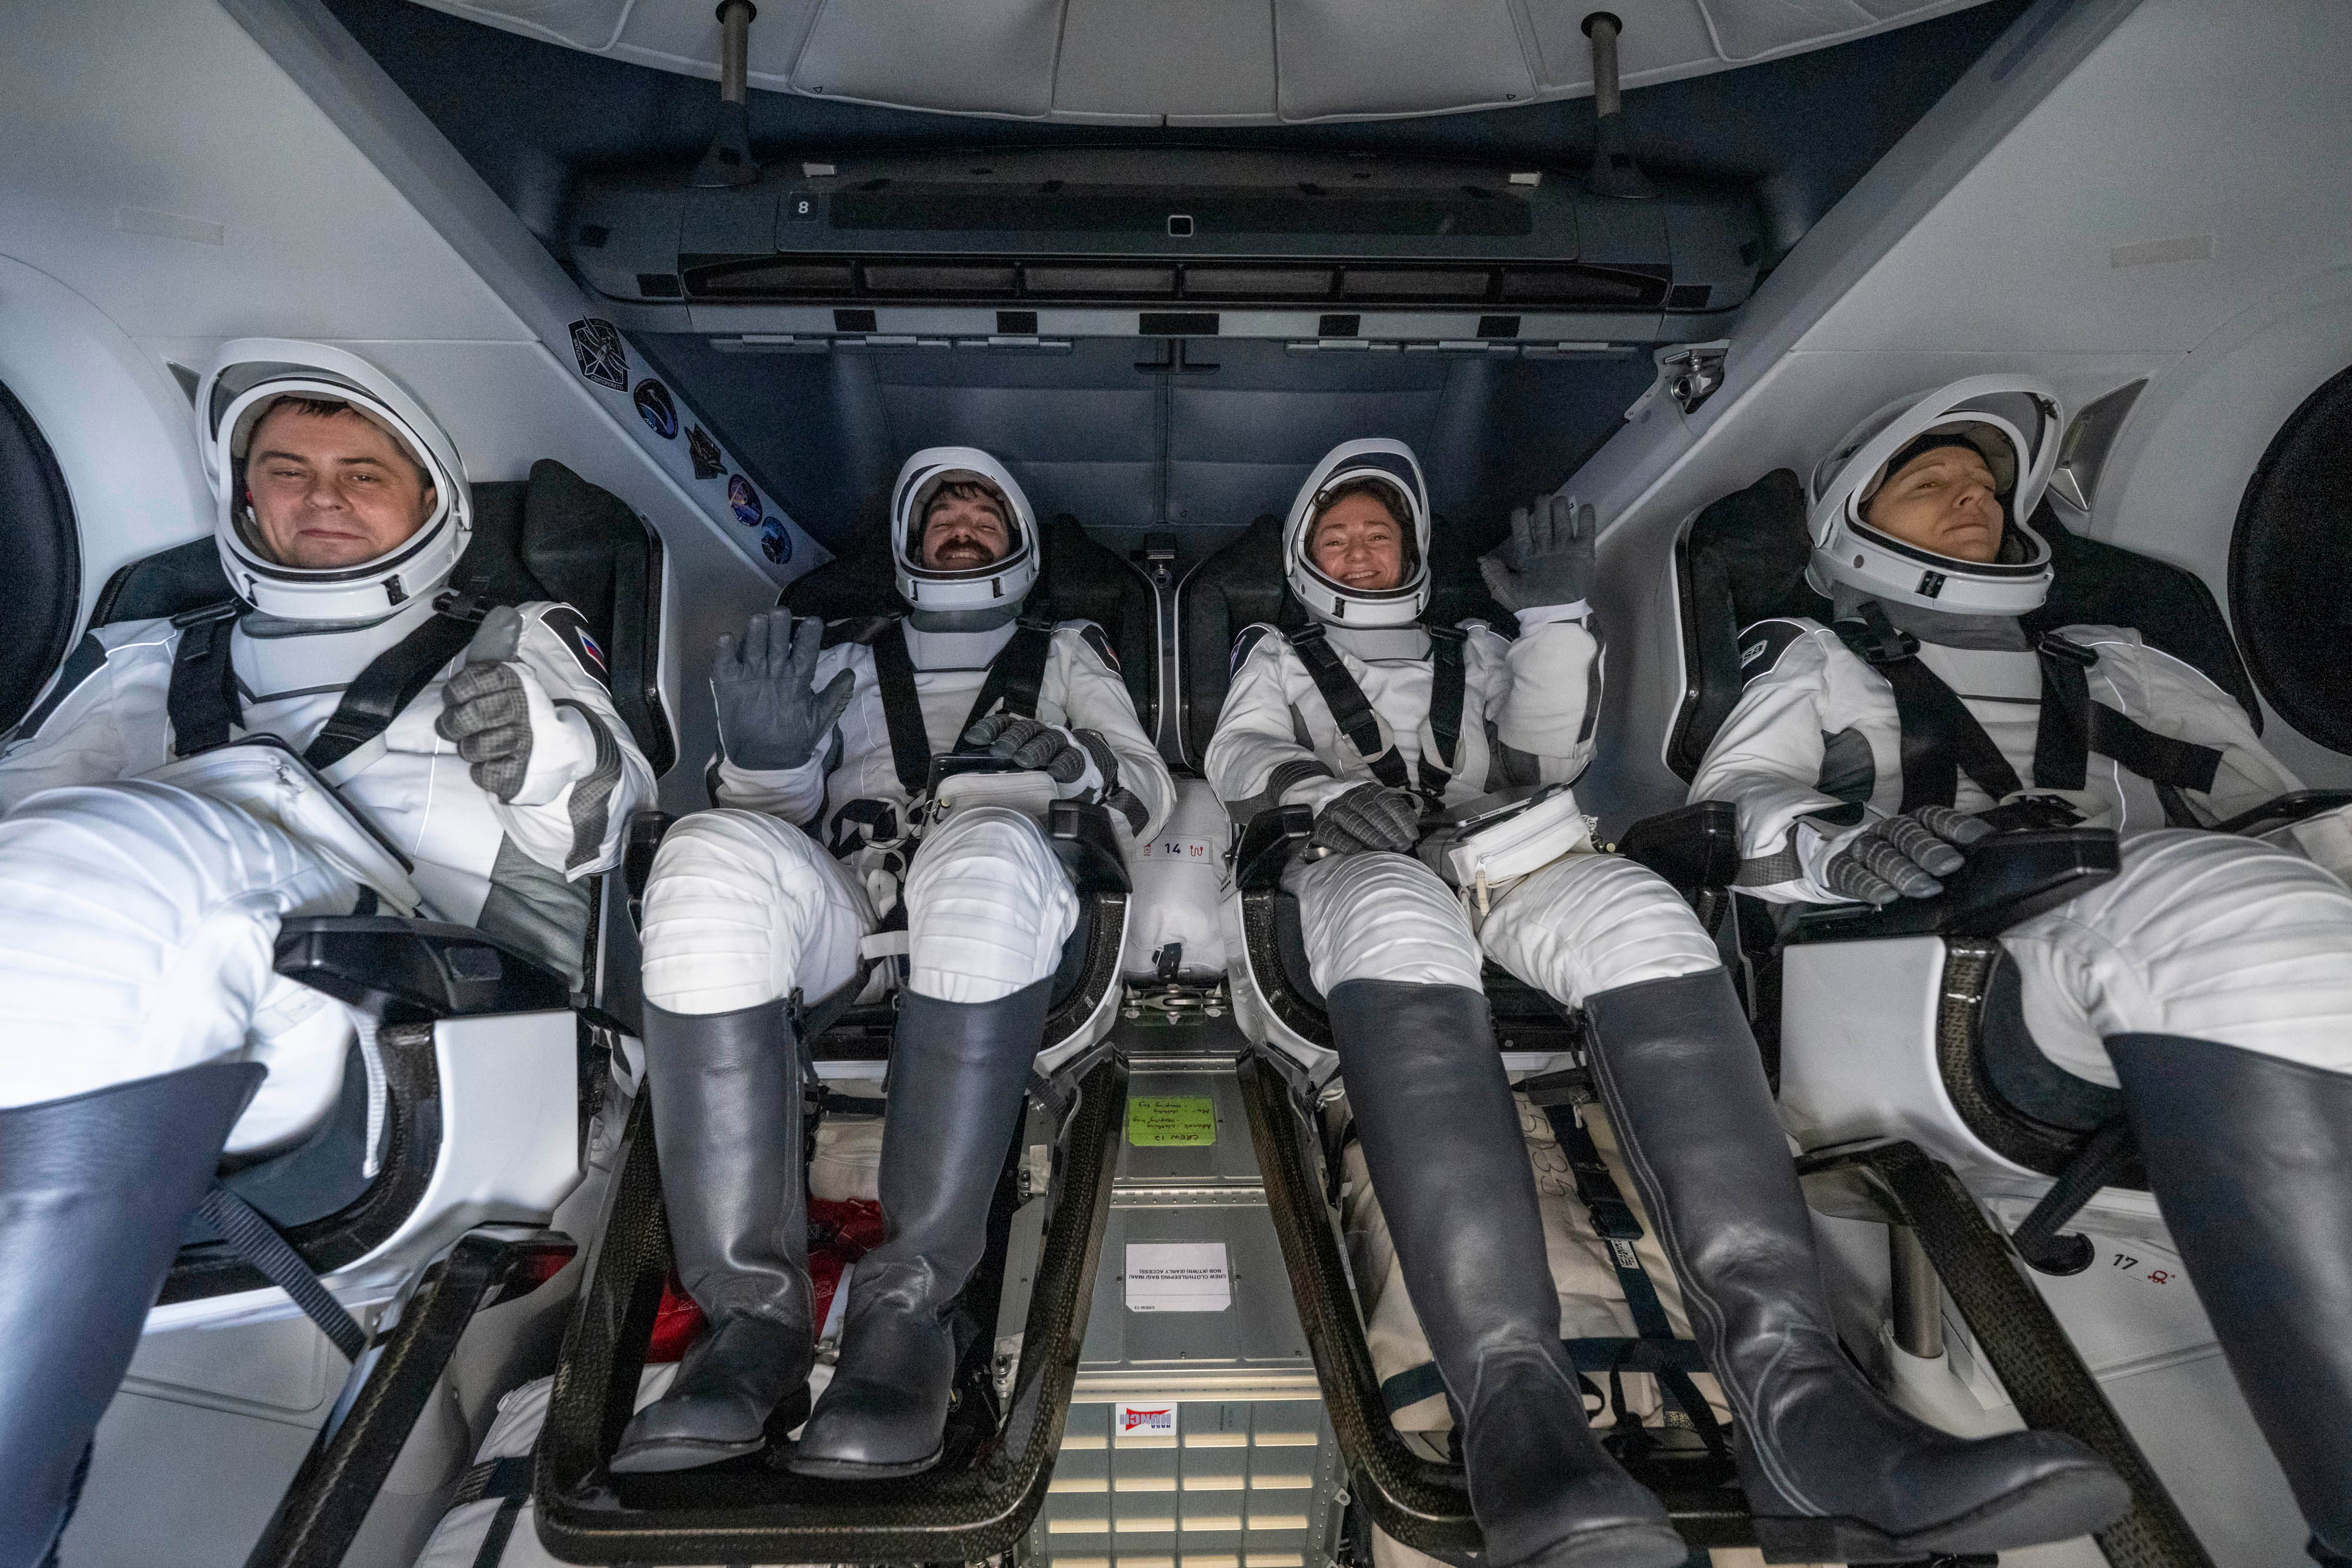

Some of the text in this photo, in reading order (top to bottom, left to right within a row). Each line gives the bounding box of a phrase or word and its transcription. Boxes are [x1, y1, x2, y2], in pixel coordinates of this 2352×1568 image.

[799, 201, 809, 215] 8
[573, 339, 583, 361] WATKINS
[591, 376, 623, 390] CRISTOFORETTI
[1741, 645, 1763, 662] sa
[1165, 843, 1181, 854] 14
[2113, 1253, 2139, 1270] 17
[1120, 1413, 1171, 1425] HUNCH
